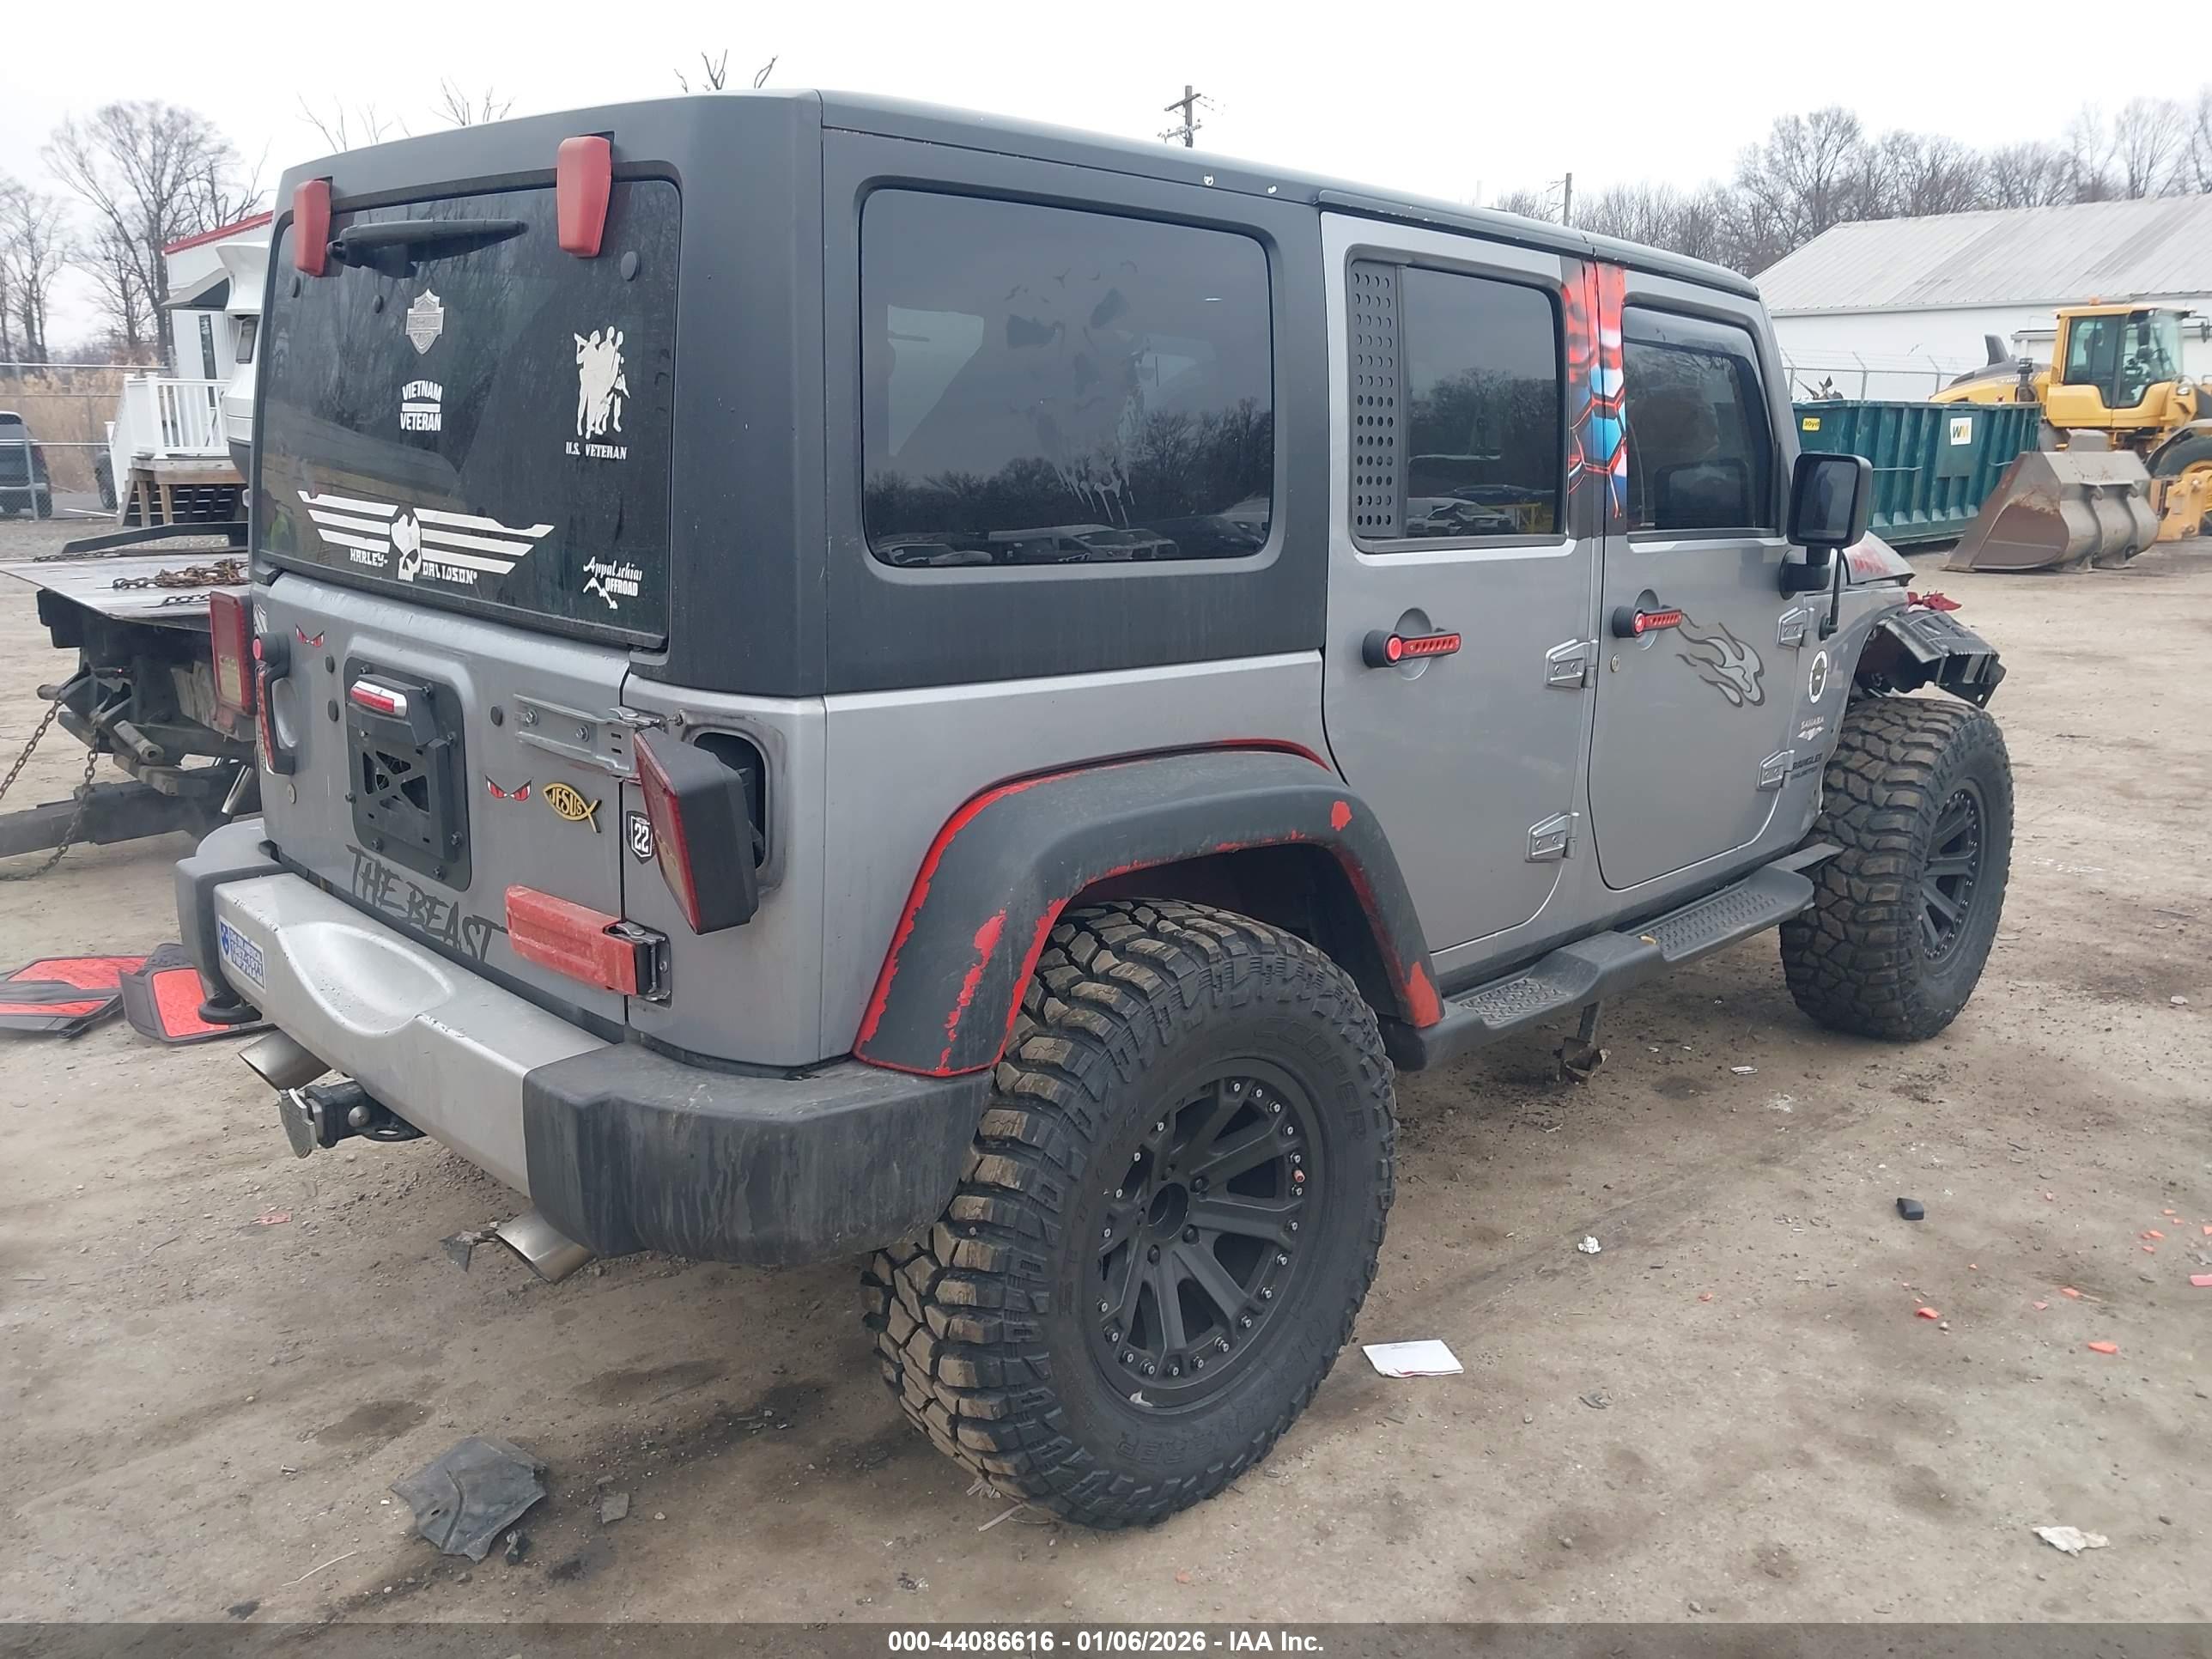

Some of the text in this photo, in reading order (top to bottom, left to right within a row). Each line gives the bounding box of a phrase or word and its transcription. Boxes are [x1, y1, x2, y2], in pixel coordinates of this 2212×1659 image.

[402, 380, 443, 402] VIETNAM
[400, 412, 442, 432] VETERAN
[1953, 425, 1969, 438] WM
[565, 441, 628, 460] U.S. VETERAN
[605, 577, 639, 597] OFFROAD
[549, 787, 583, 816] JESUS
[635, 822, 649, 854] 22
[345, 844, 509, 962] THE BEAST
